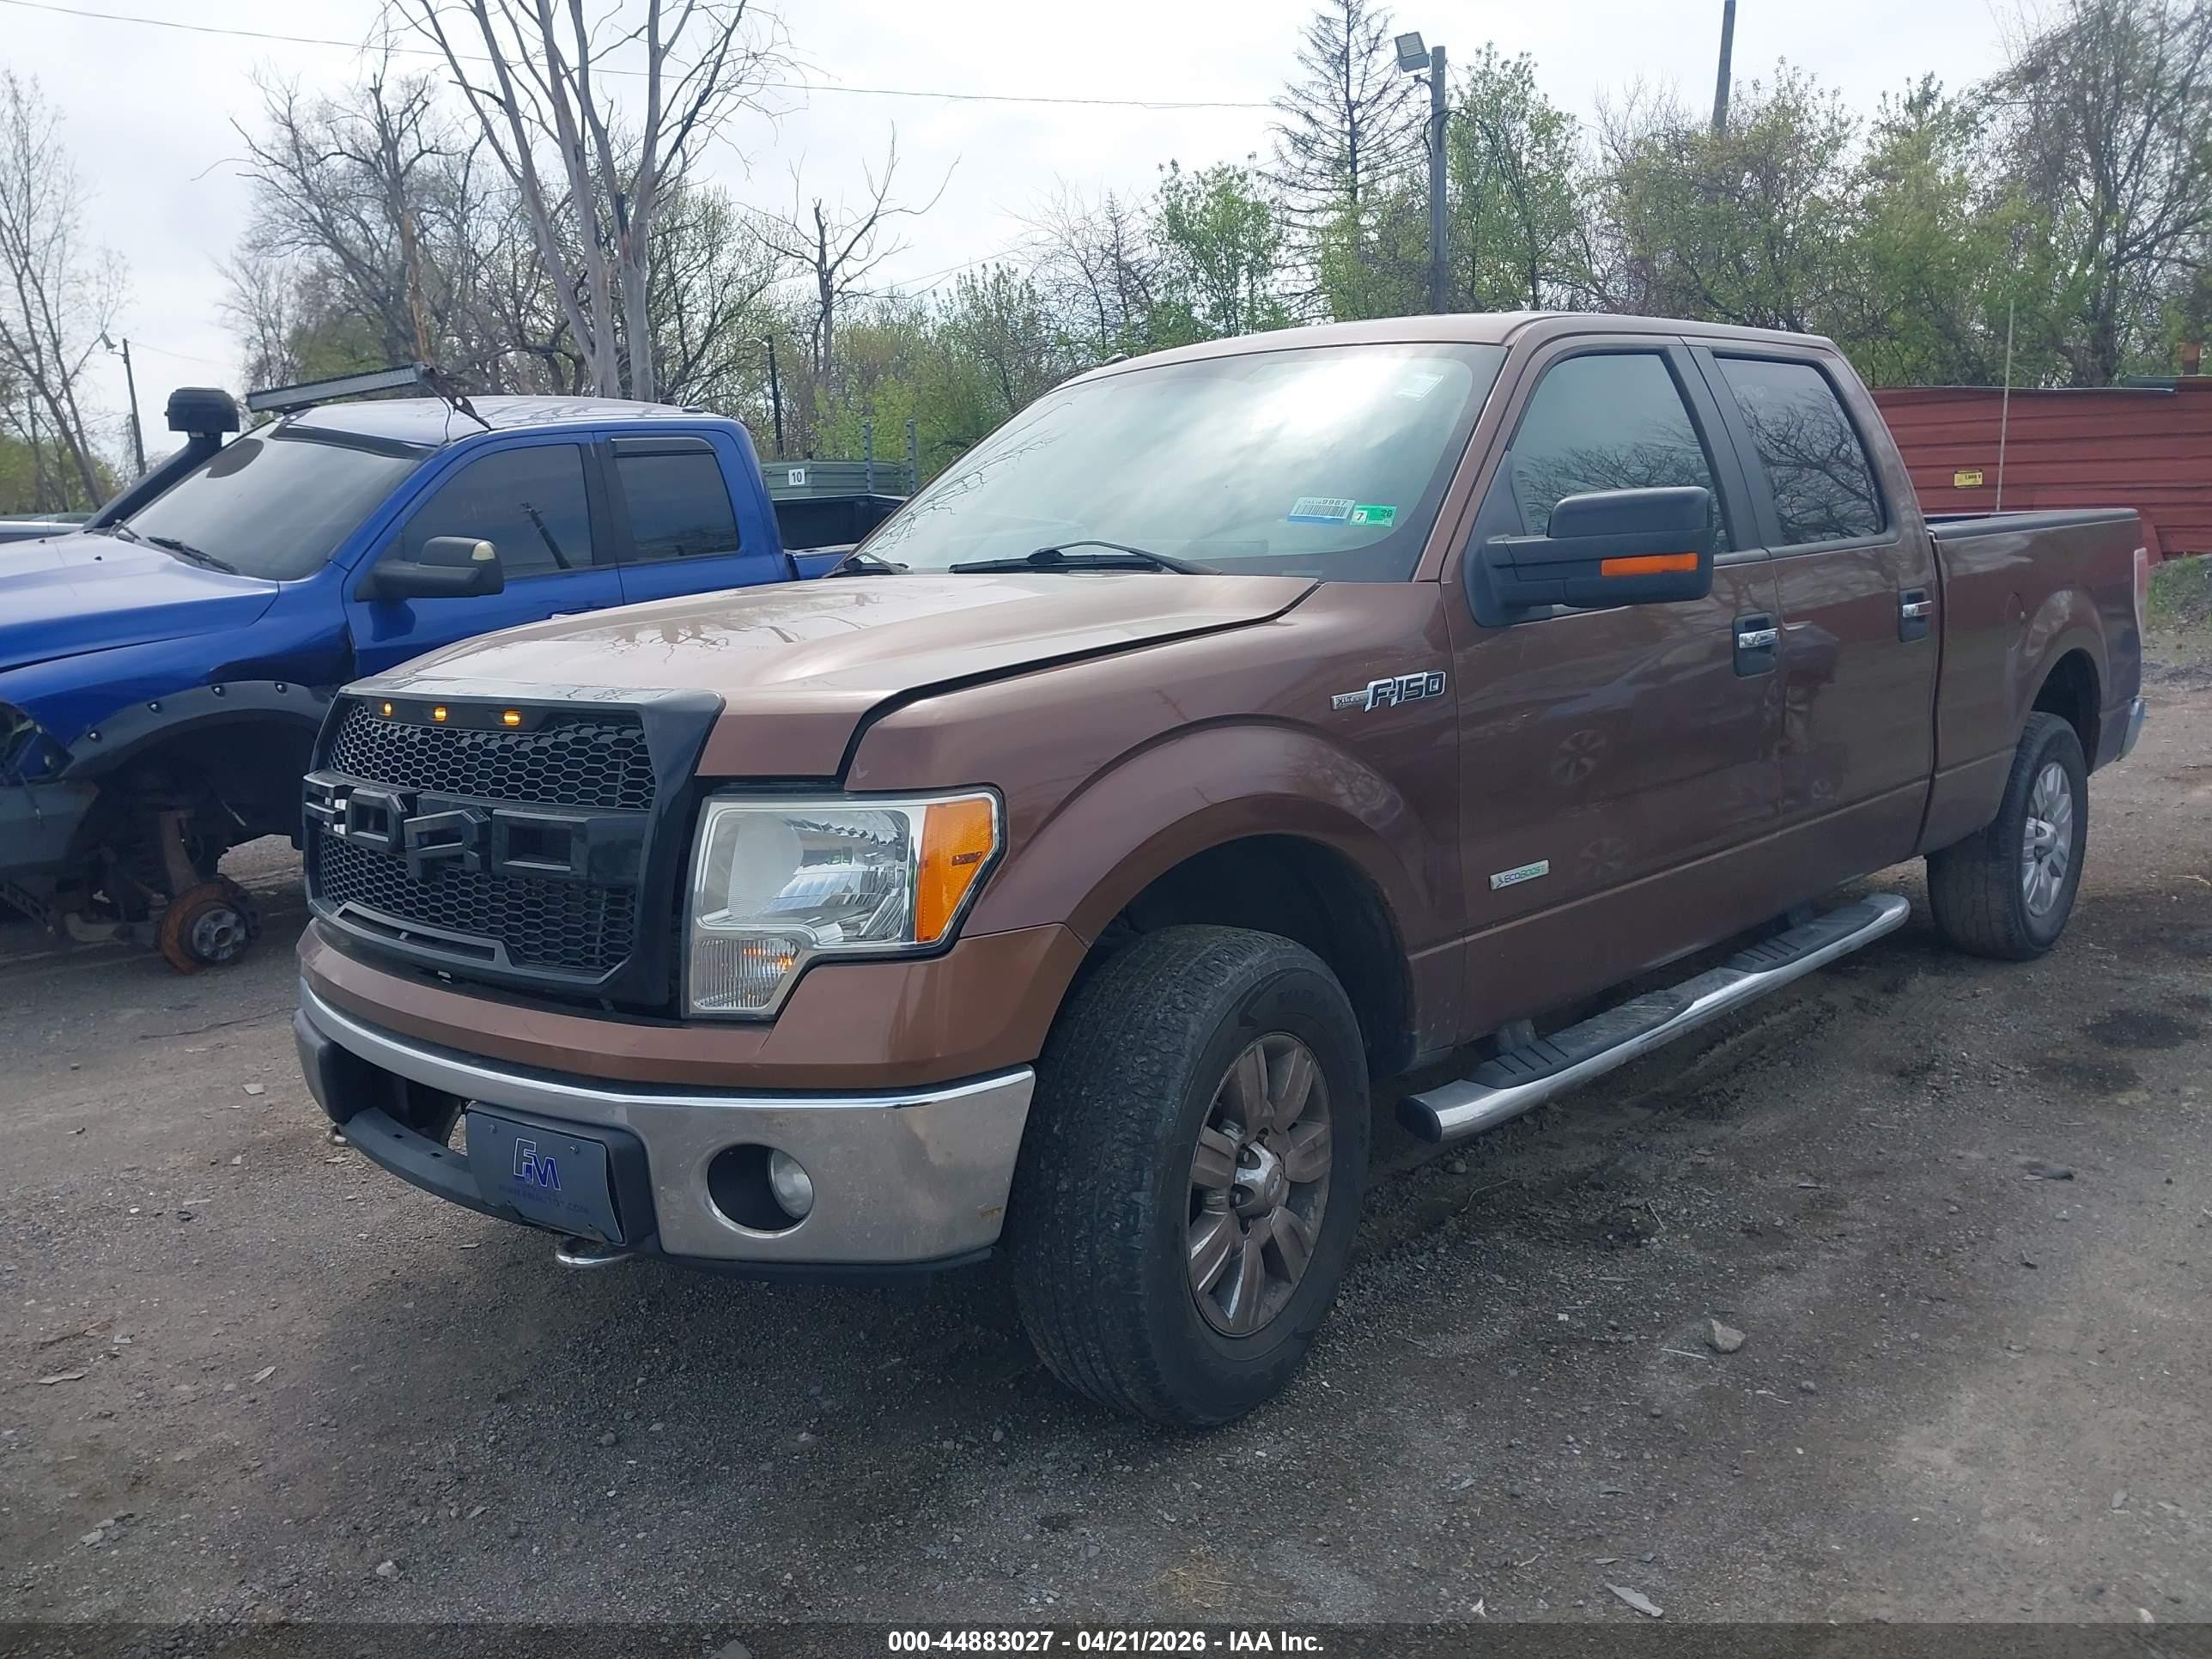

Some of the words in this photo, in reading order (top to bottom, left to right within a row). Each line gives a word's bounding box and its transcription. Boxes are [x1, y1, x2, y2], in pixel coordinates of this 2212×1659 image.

[792, 471, 803, 483] 10
[1358, 512, 1364, 521] 7
[1365, 672, 1447, 713] F-150
[301, 770, 593, 882] FORD
